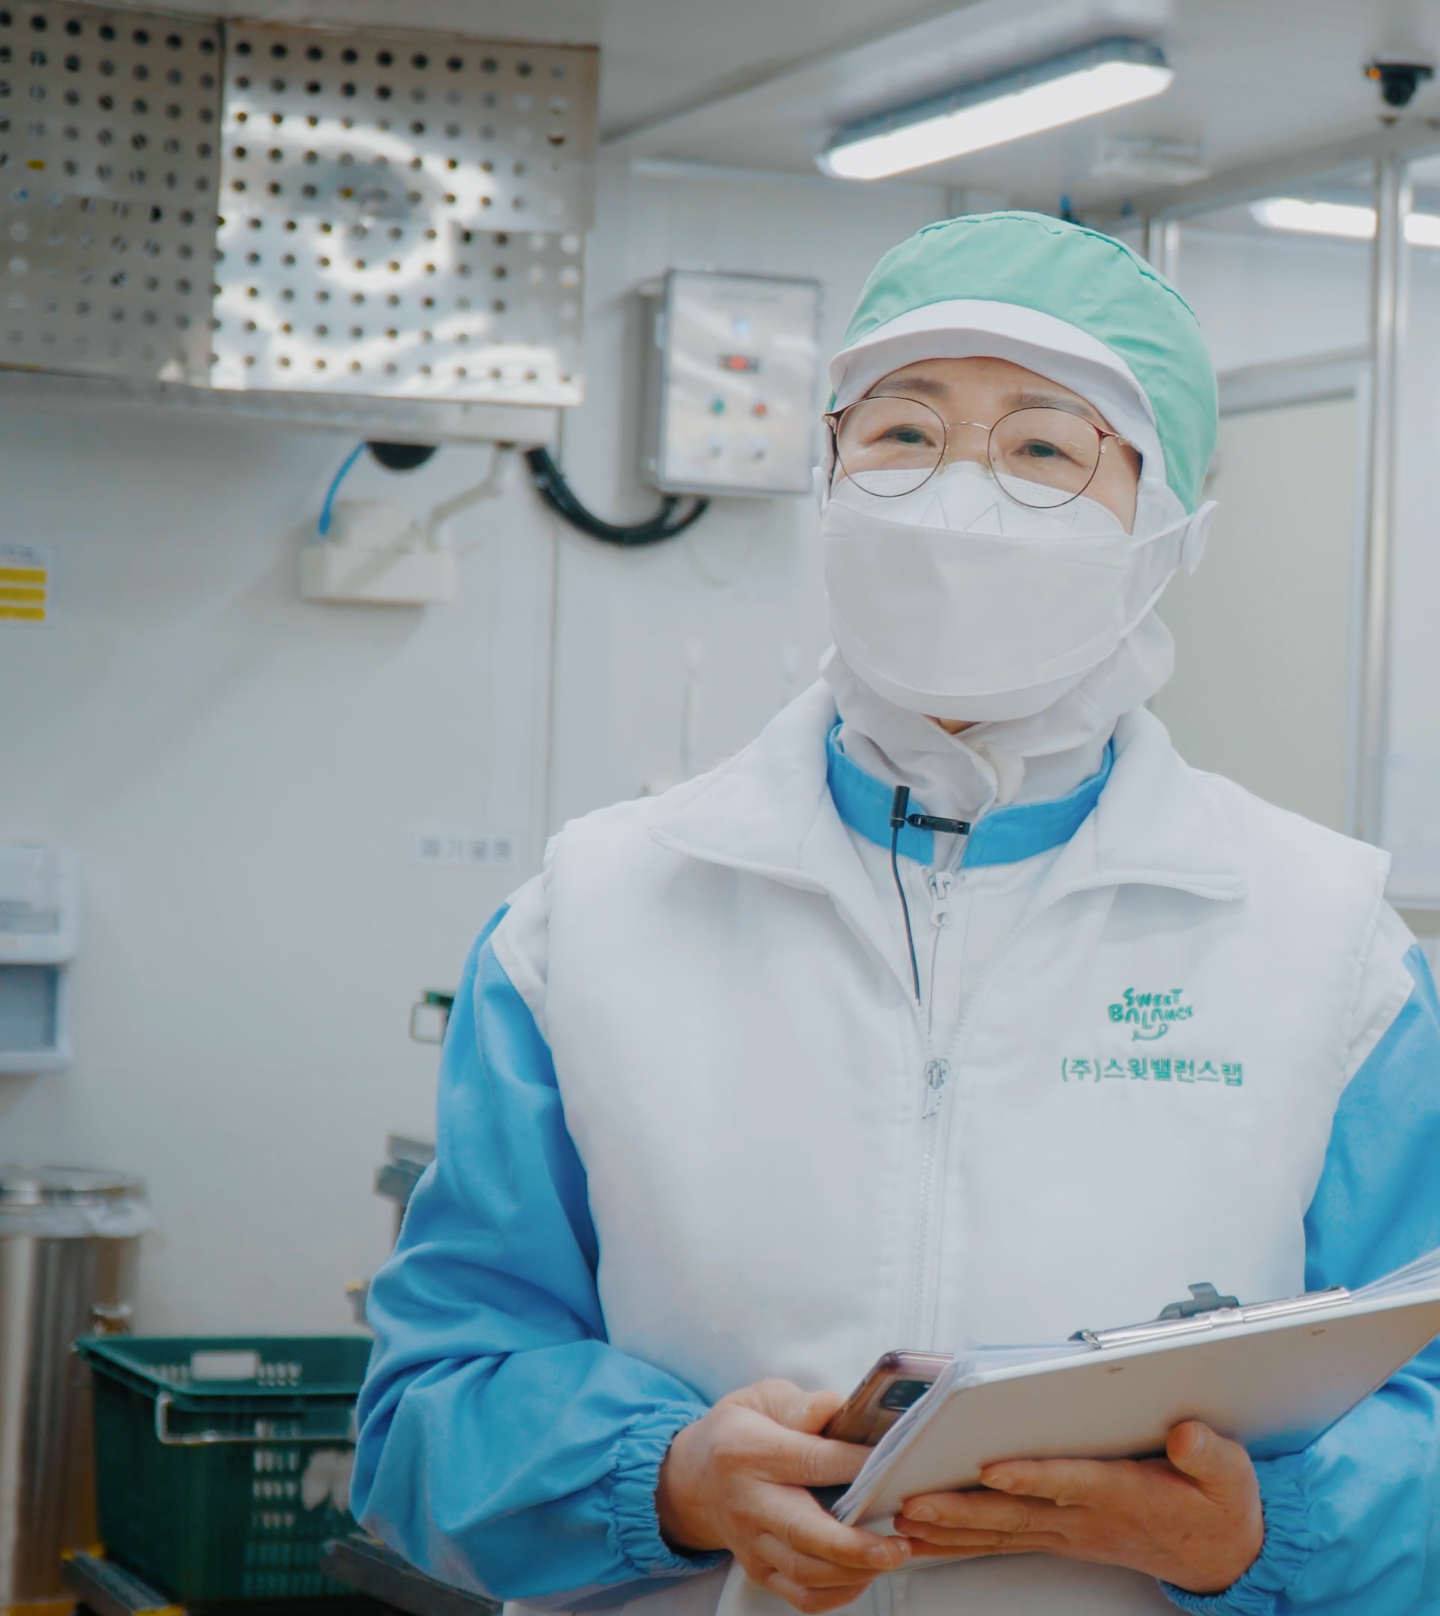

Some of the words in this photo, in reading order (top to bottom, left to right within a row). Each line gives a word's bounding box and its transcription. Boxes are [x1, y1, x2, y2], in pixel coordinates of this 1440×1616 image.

[1123, 988, 1183, 1007] SWEET
[1108, 1003, 1194, 1030] BALANCE
[1061, 1057, 1243, 1086] (주)스윗밸런스랩
